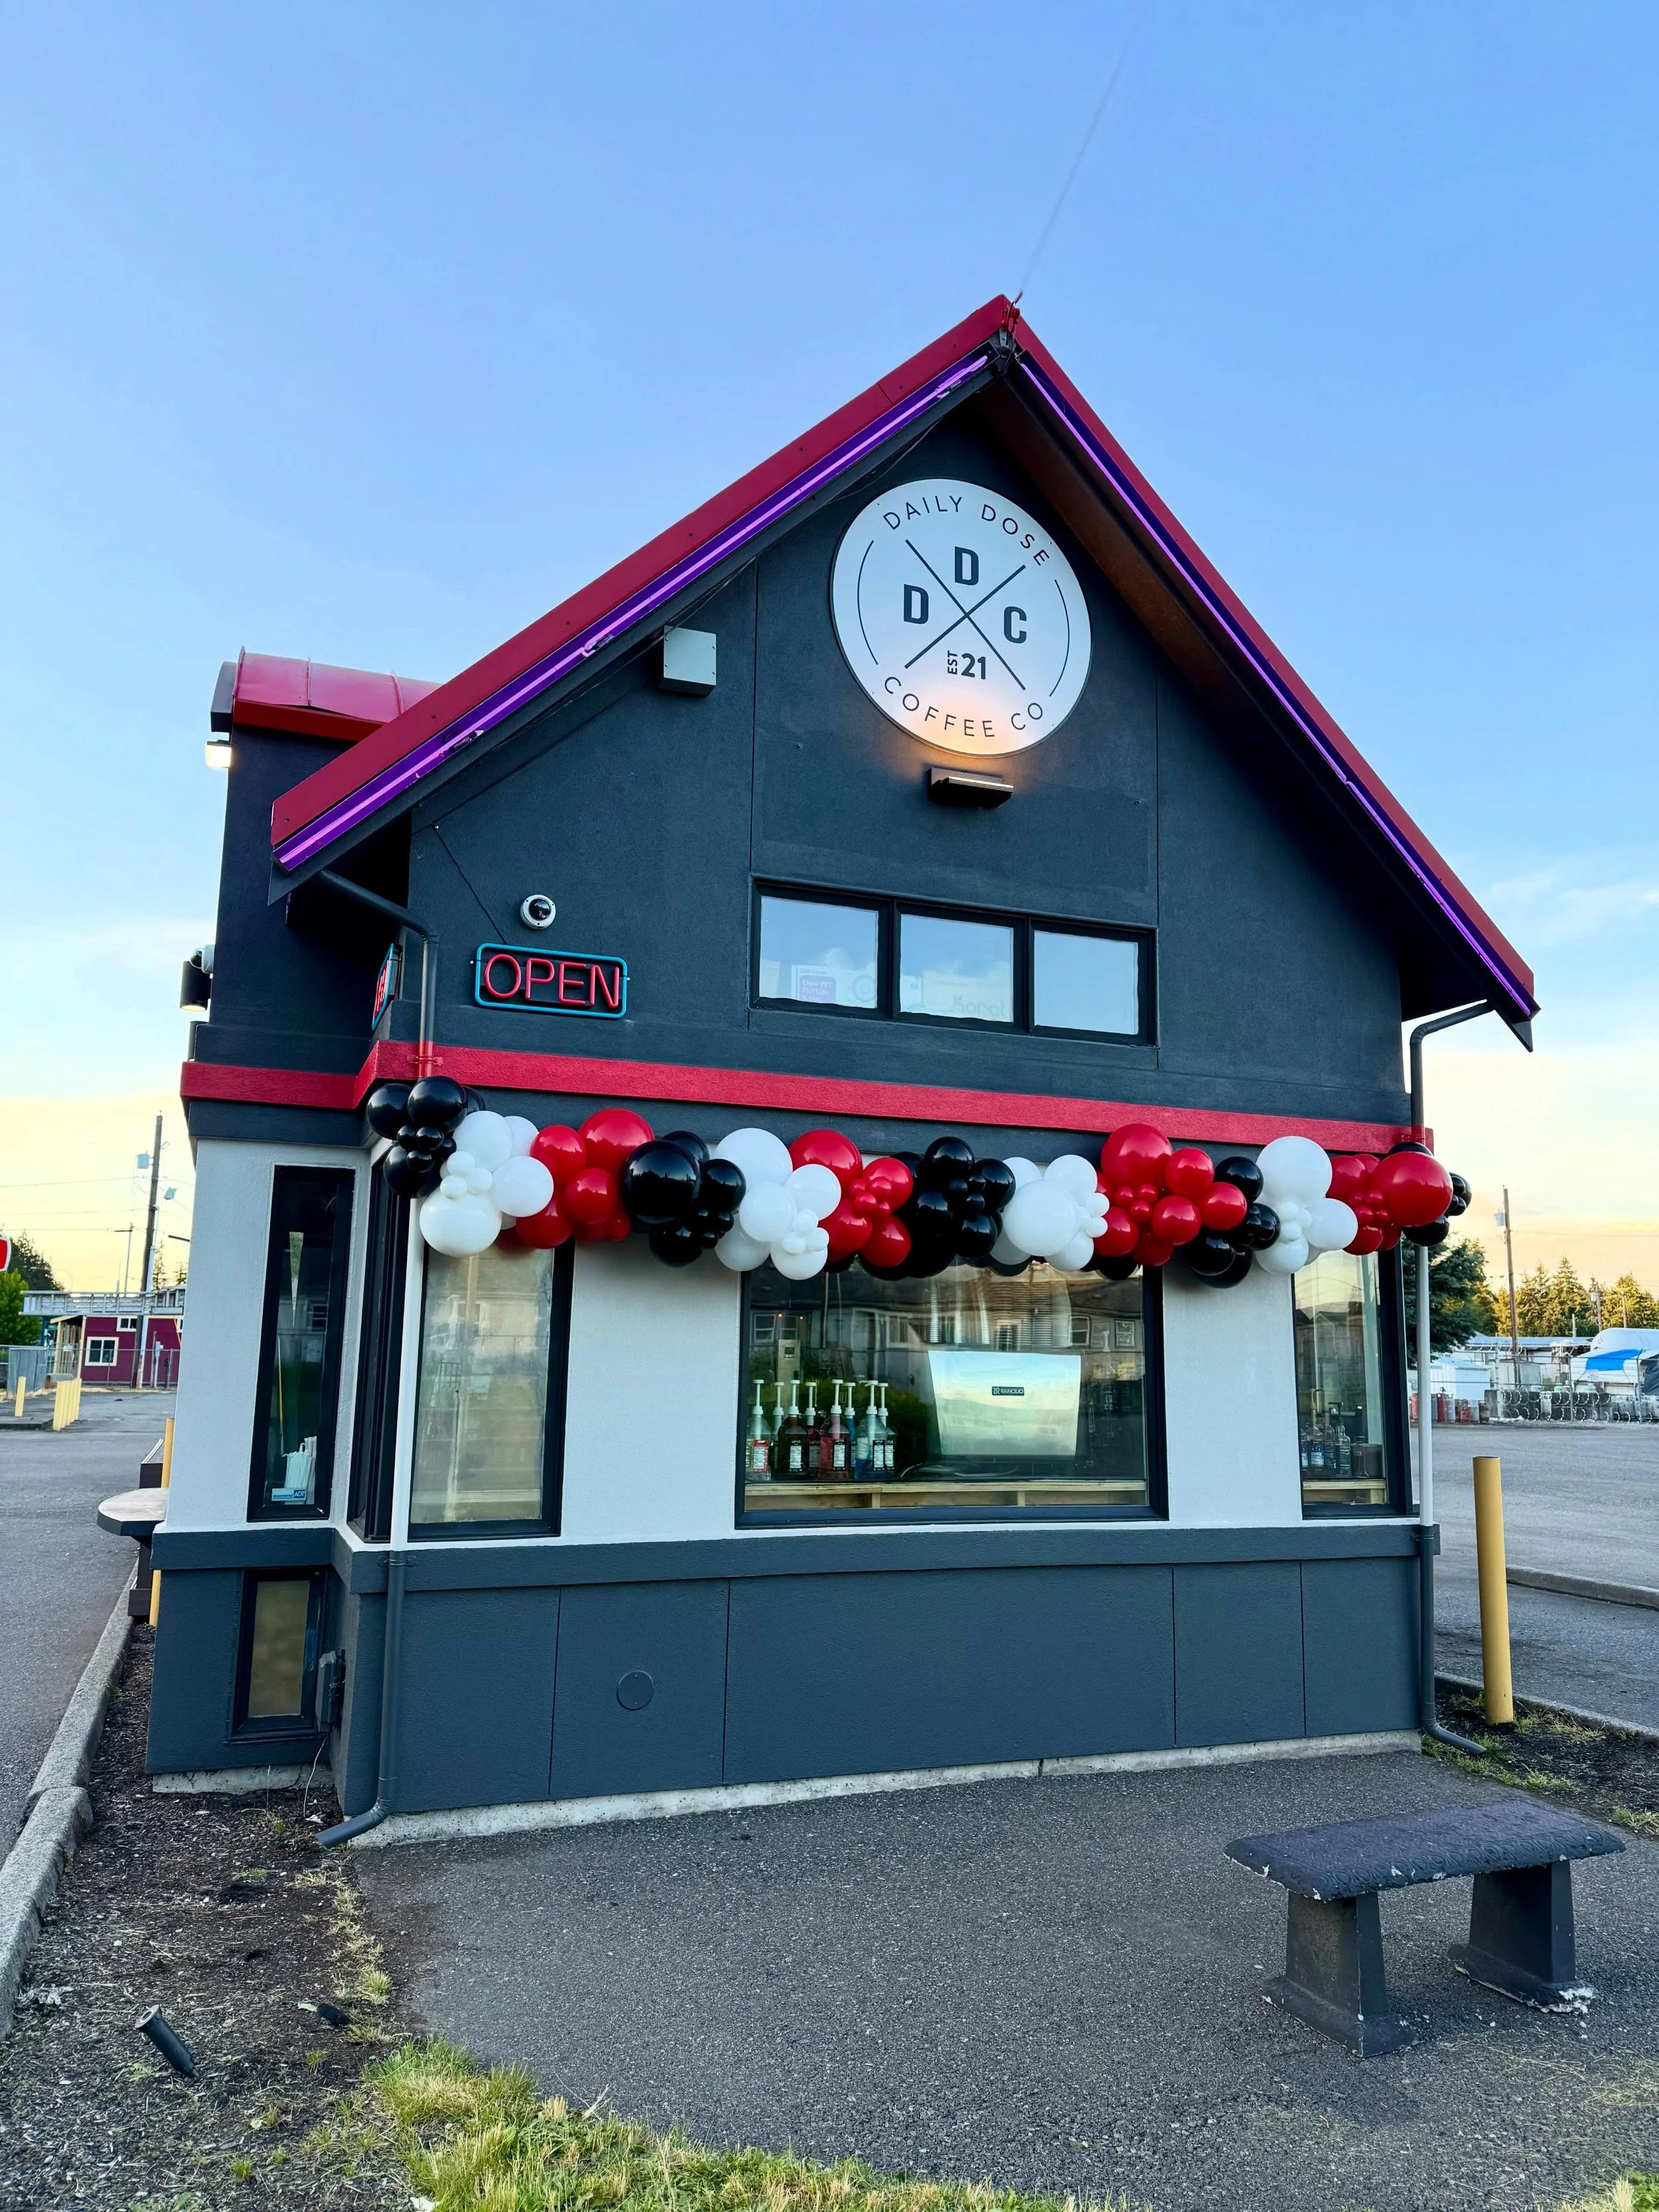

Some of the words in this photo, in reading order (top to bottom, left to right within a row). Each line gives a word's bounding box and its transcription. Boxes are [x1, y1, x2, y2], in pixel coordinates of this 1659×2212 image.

[883, 495, 962, 530] DAILY
[981, 504, 1050, 566] DOSE
[954, 546, 979, 586] D
[903, 583, 929, 625] D
[1003, 606, 1027, 644] C
[947, 650, 958, 675] EST
[961, 653, 986, 680] 21
[884, 676, 995, 737] COFFEE
[1011, 702, 1043, 731] CO
[484, 953, 620, 1009] OPEN
[953, 994, 1007, 1017] Karat
